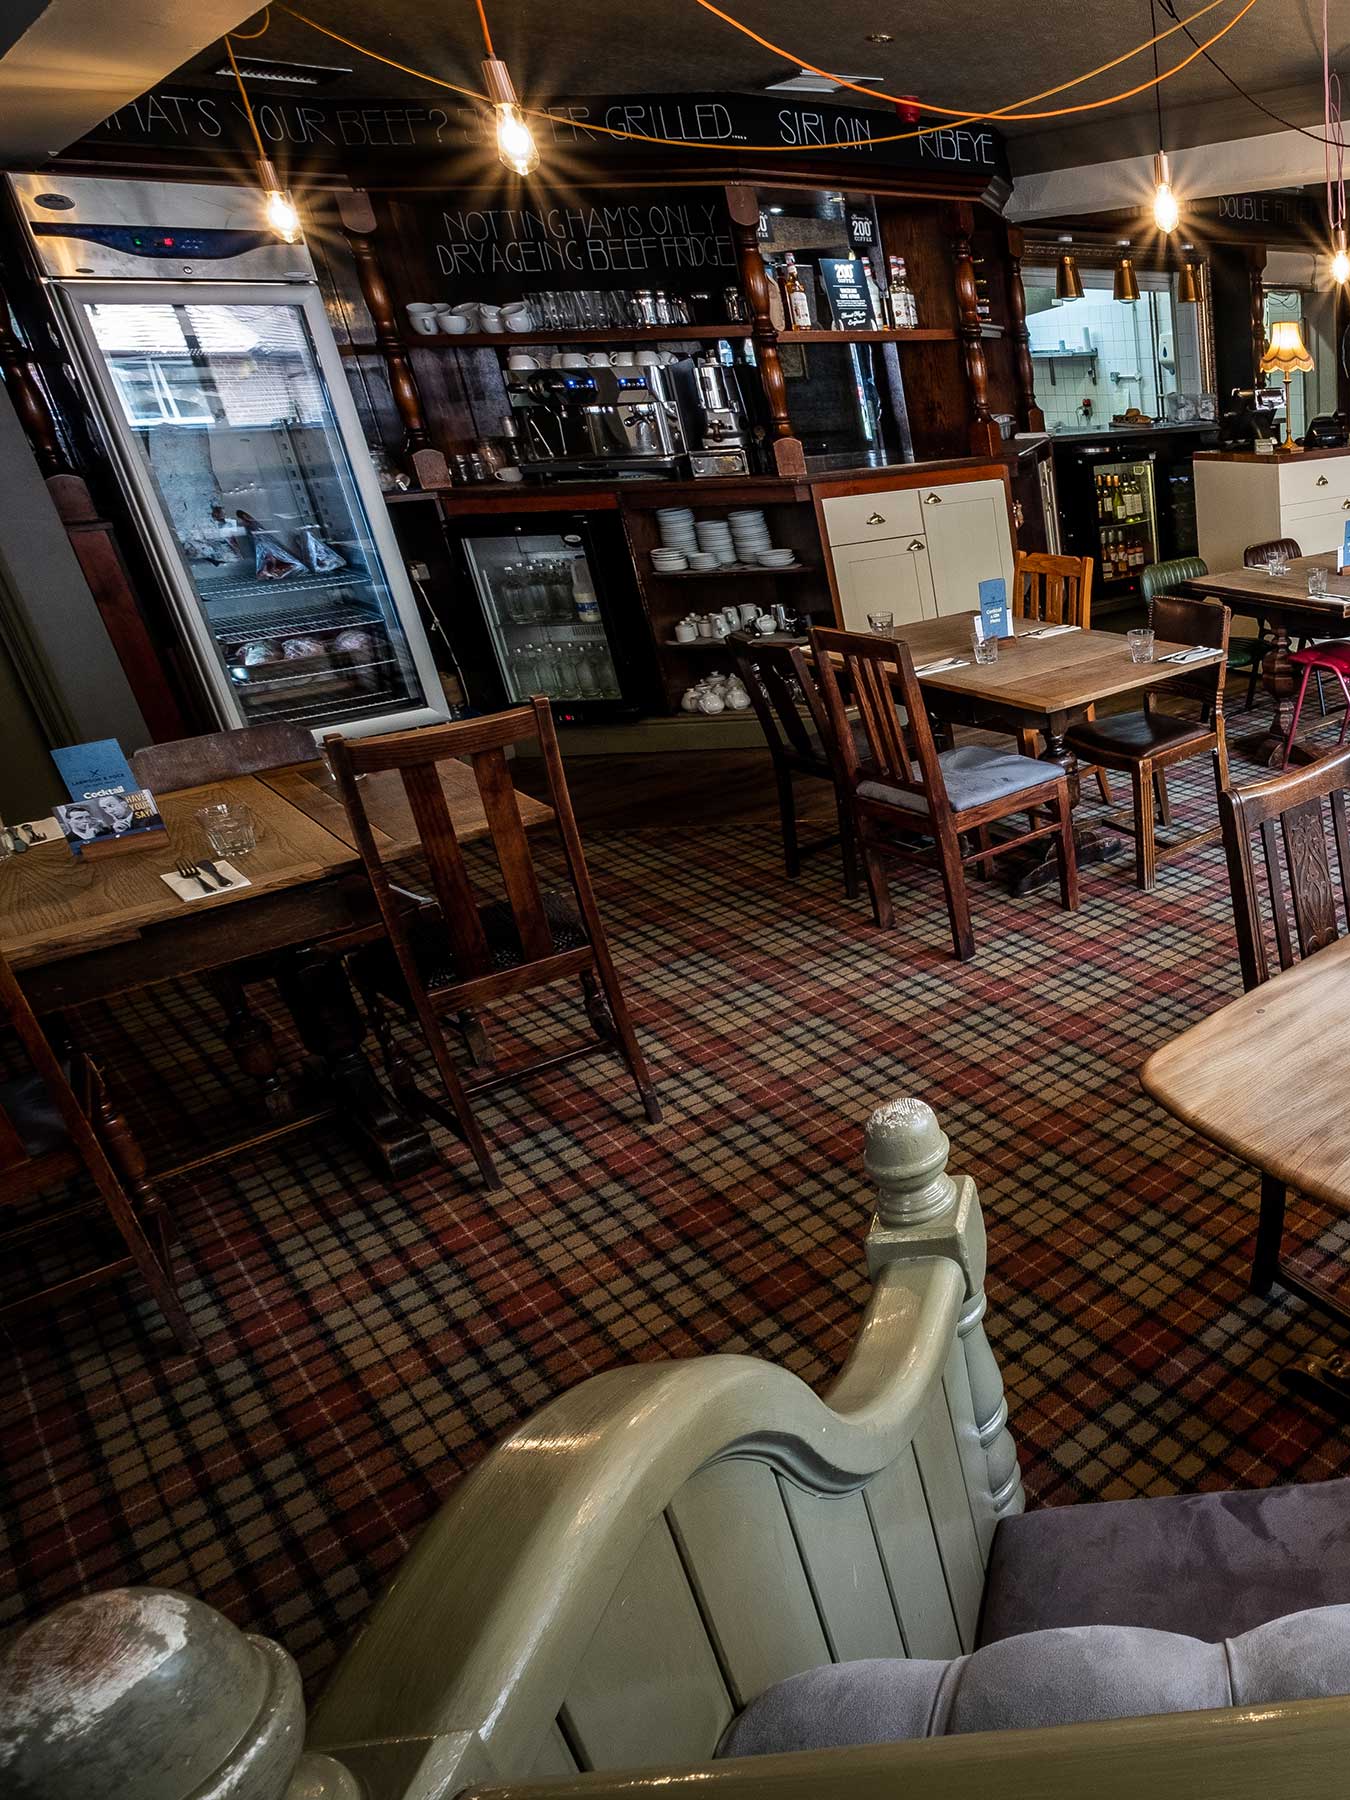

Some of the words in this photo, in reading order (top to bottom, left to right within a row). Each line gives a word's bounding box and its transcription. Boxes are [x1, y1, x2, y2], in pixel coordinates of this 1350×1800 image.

[101, 95, 221, 137] HAT'S
[336, 108, 448, 146] BEEF?
[778, 110, 873, 152] SIRLOIN
[917, 125, 996, 164] RIBEYE
[442, 206, 643, 241] NOTTINGHAM'S
[649, 205, 716, 236] ONLY
[1218, 196, 1272, 222] DOUBLE
[587, 237, 657, 270] BEEF
[660, 235, 737, 267] FRIDGE
[83, 785, 125, 800] Cocktail
[125, 792, 148, 804] HAVE
[128, 801, 151, 812] YOUR
